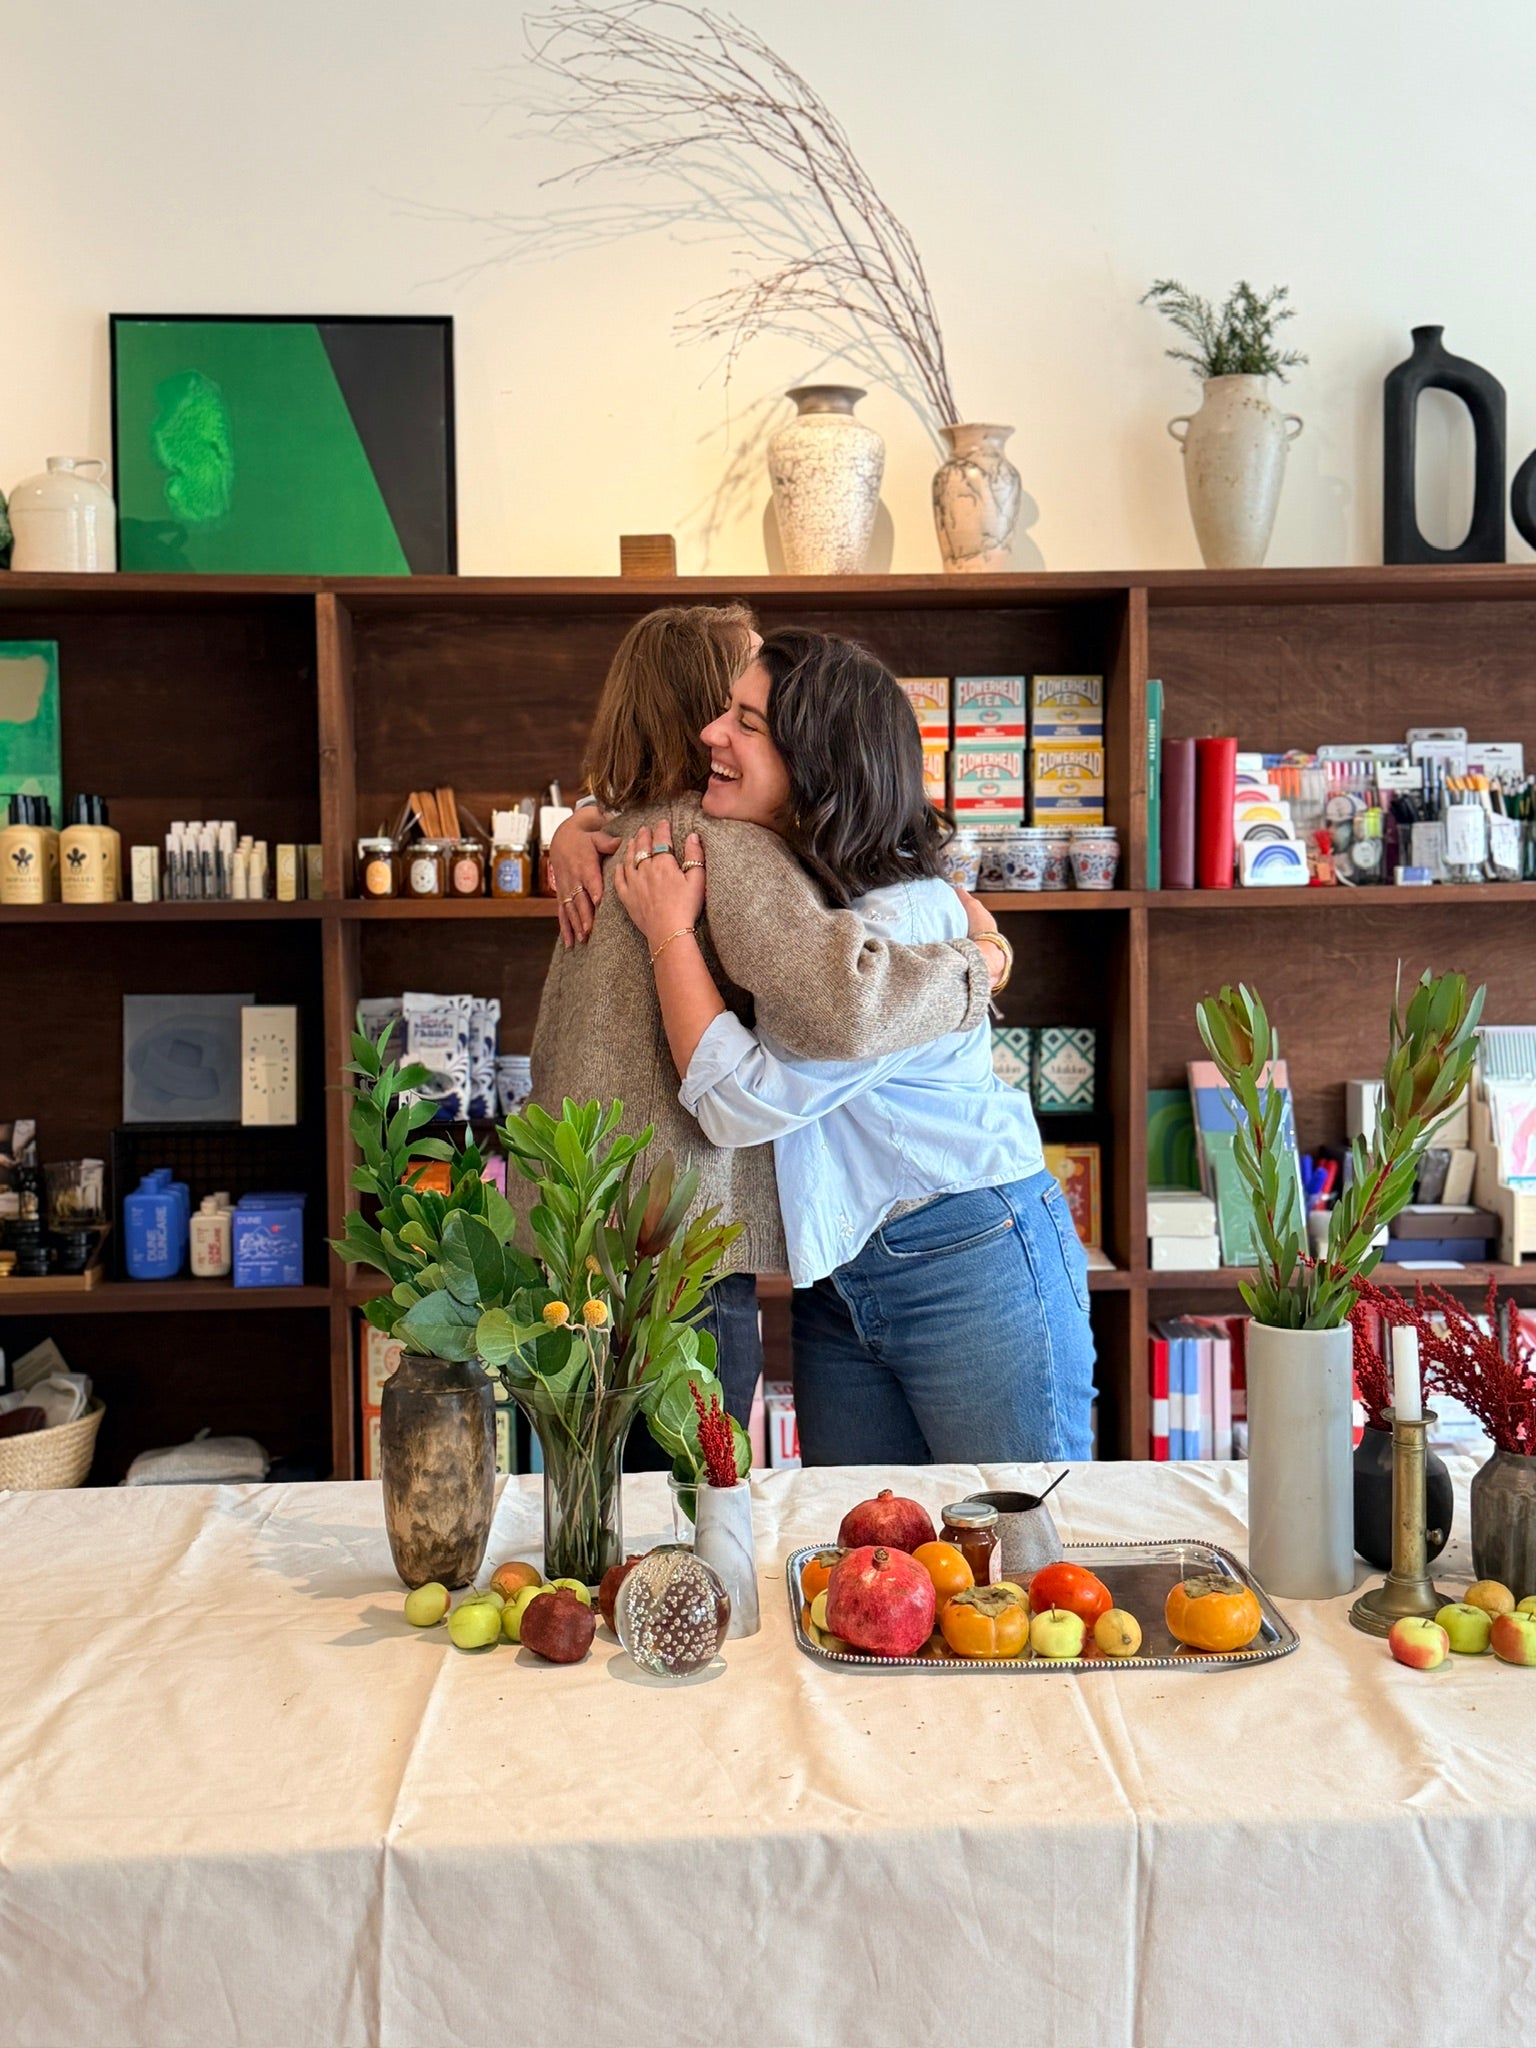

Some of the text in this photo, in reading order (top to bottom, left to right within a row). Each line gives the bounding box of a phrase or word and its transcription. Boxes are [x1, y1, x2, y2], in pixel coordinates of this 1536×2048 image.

[901, 681, 946, 707] WERHEAD
[957, 680, 1021, 708] FLOWERHEAD
[976, 695, 1002, 708] TEA
[1036, 679, 1101, 707] FLOWERHEAD
[1055, 694, 1081, 706] TEA
[957, 752, 1021, 780] FLOWERHEAD
[975, 767, 1001, 780] TEA
[1037, 752, 1102, 779] FLOWERHEAD
[1056, 766, 1082, 778] TEA
[237, 1216, 262, 1225] DUNE
[147, 1229, 157, 1262] DUNE
[156, 1206, 168, 1262] SUNCARE
